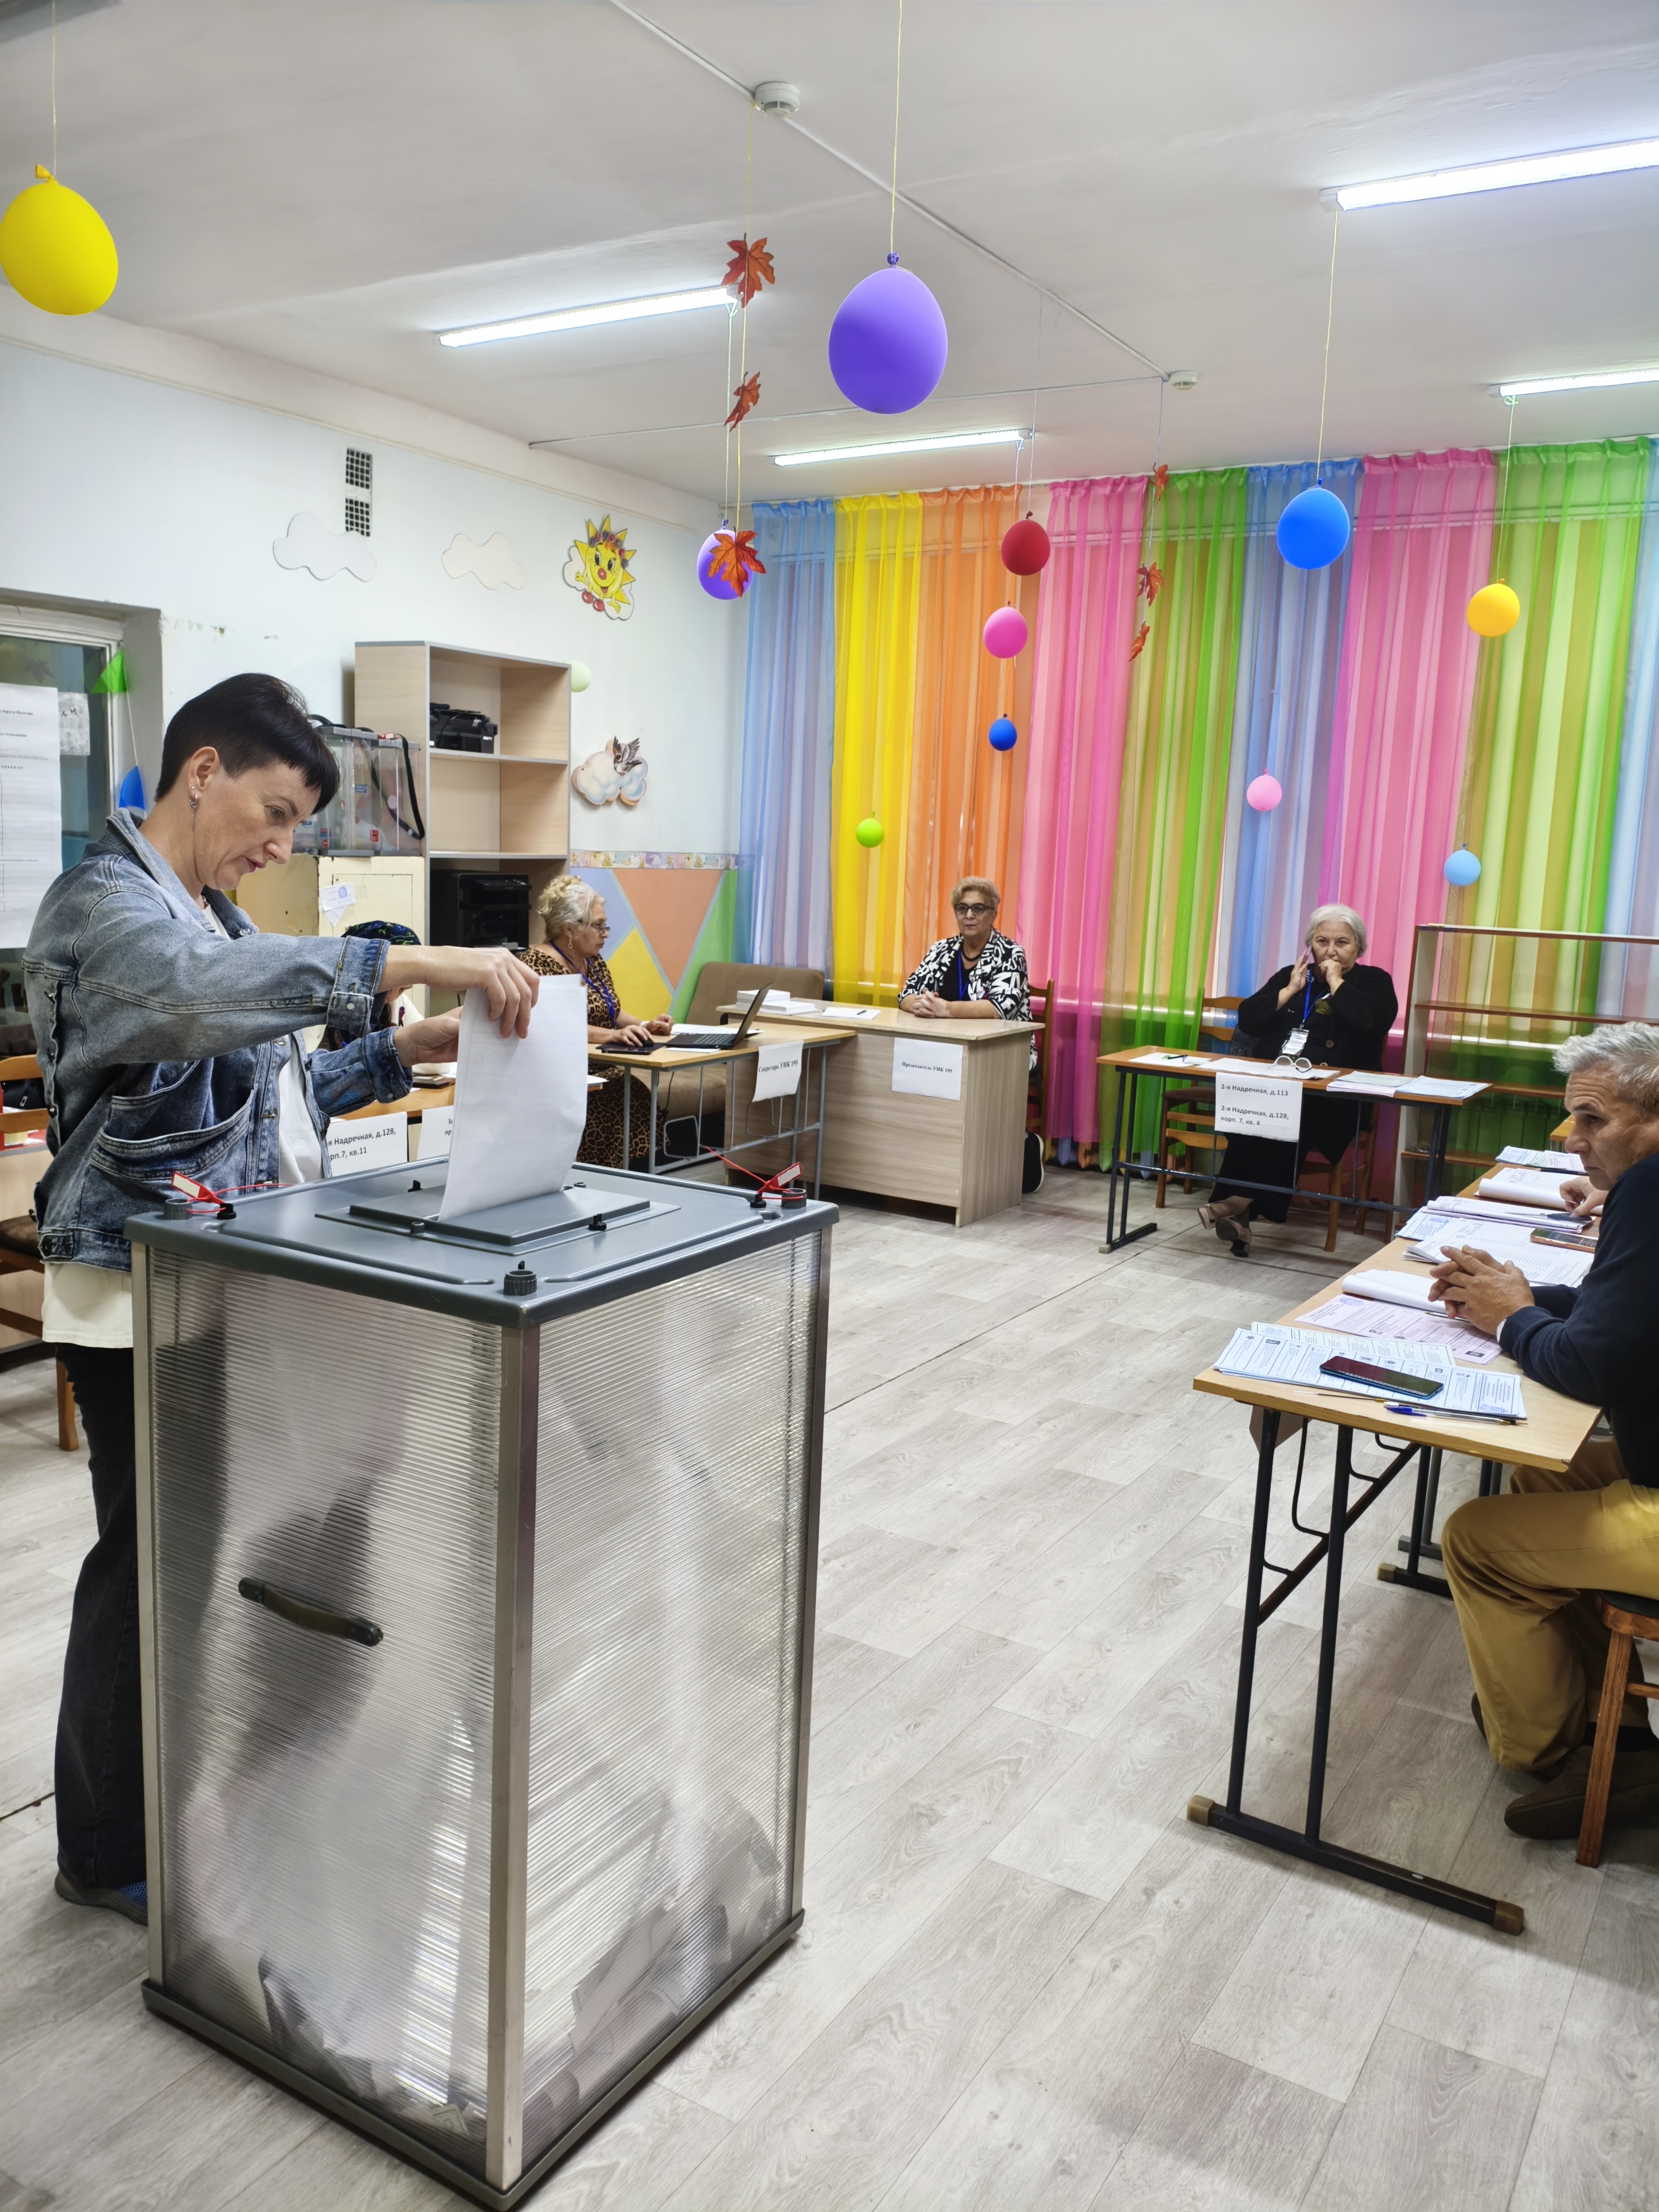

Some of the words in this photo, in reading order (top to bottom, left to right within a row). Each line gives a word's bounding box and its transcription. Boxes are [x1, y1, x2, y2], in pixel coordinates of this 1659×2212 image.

[758, 1065, 779, 1073] Секретарь
[780, 1061, 791, 1069] УИК
[901, 1061, 932, 1070] Председатель
[1232, 1085, 1269, 1095] Надречная,
[1232, 1107, 1267, 1117] Надречная,
[334, 1133, 374, 1144] Надречная,
[375, 1128, 396, 1139] д.128,
[330, 1150, 348, 1161] рп.7,
[349, 1147, 367, 1156] кв.11
